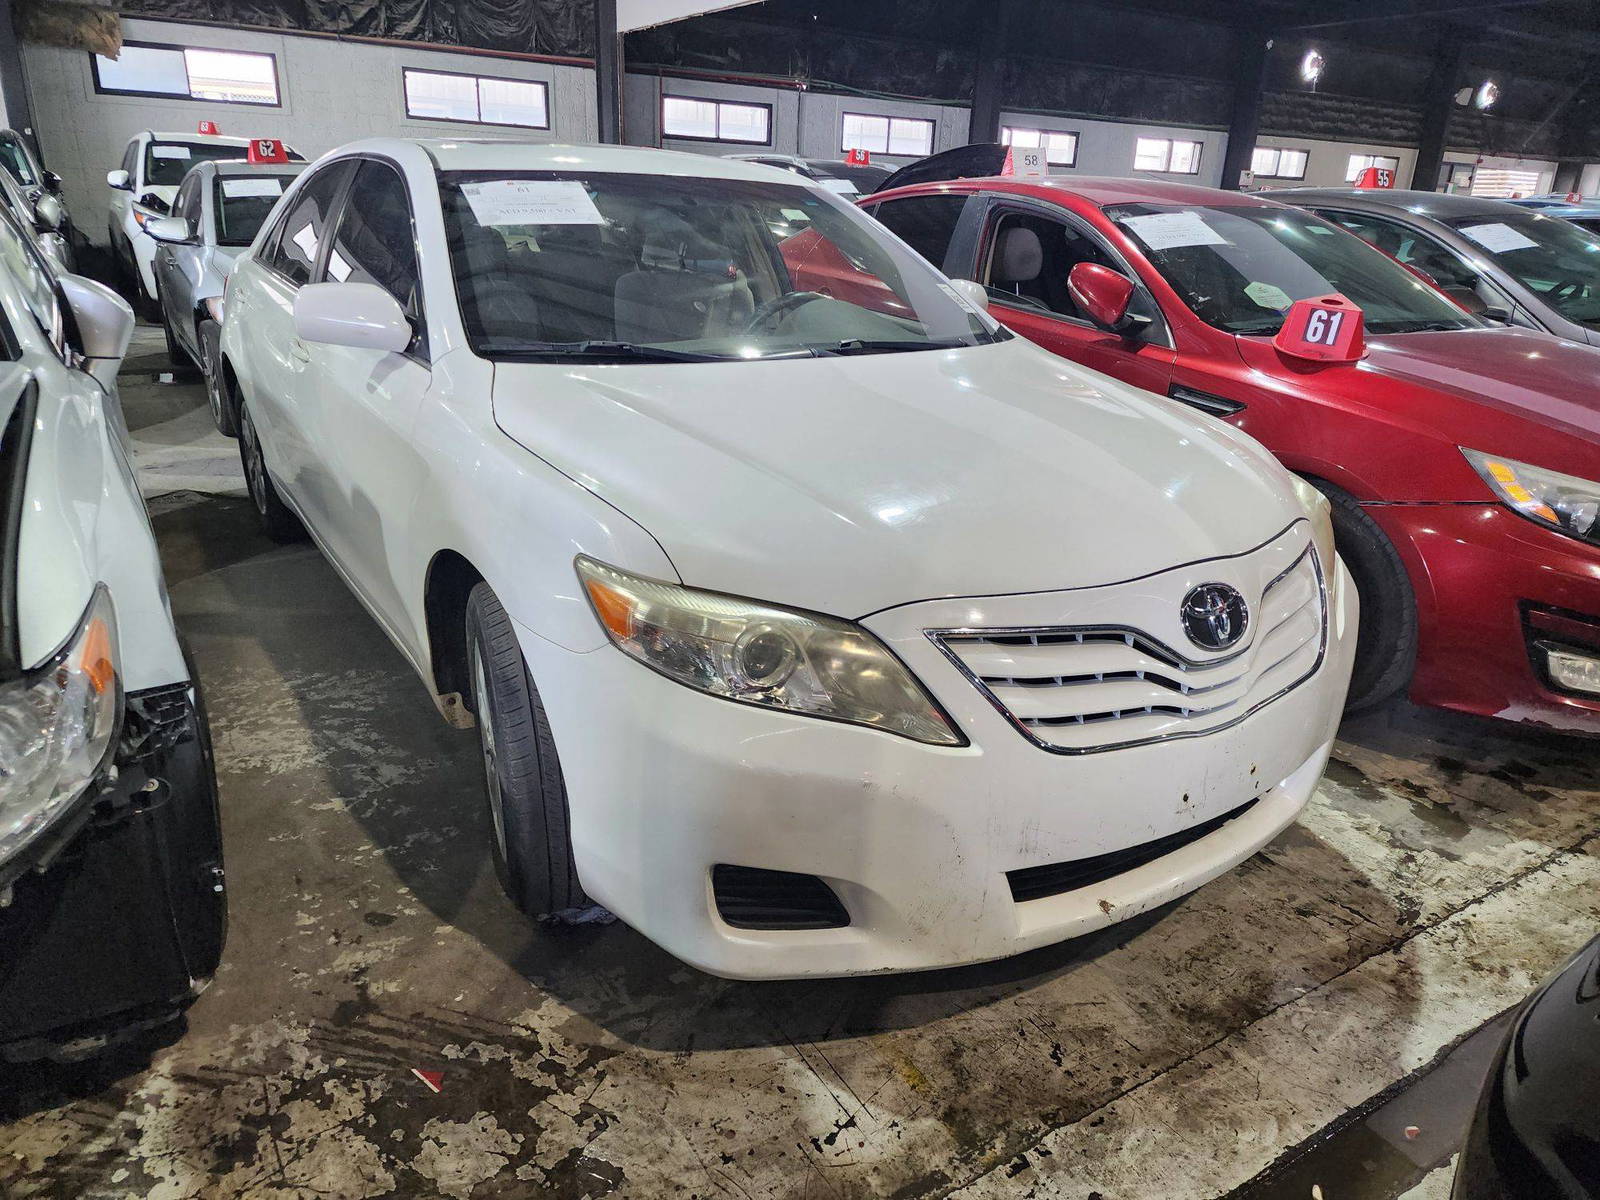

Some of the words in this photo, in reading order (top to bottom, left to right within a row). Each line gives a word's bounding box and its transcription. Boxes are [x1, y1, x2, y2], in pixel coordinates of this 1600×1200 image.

[259, 140, 275, 157] 62
[1024, 154, 1038, 166] 58
[1377, 169, 1389, 187] 55
[1306, 309, 1343, 345] 61
